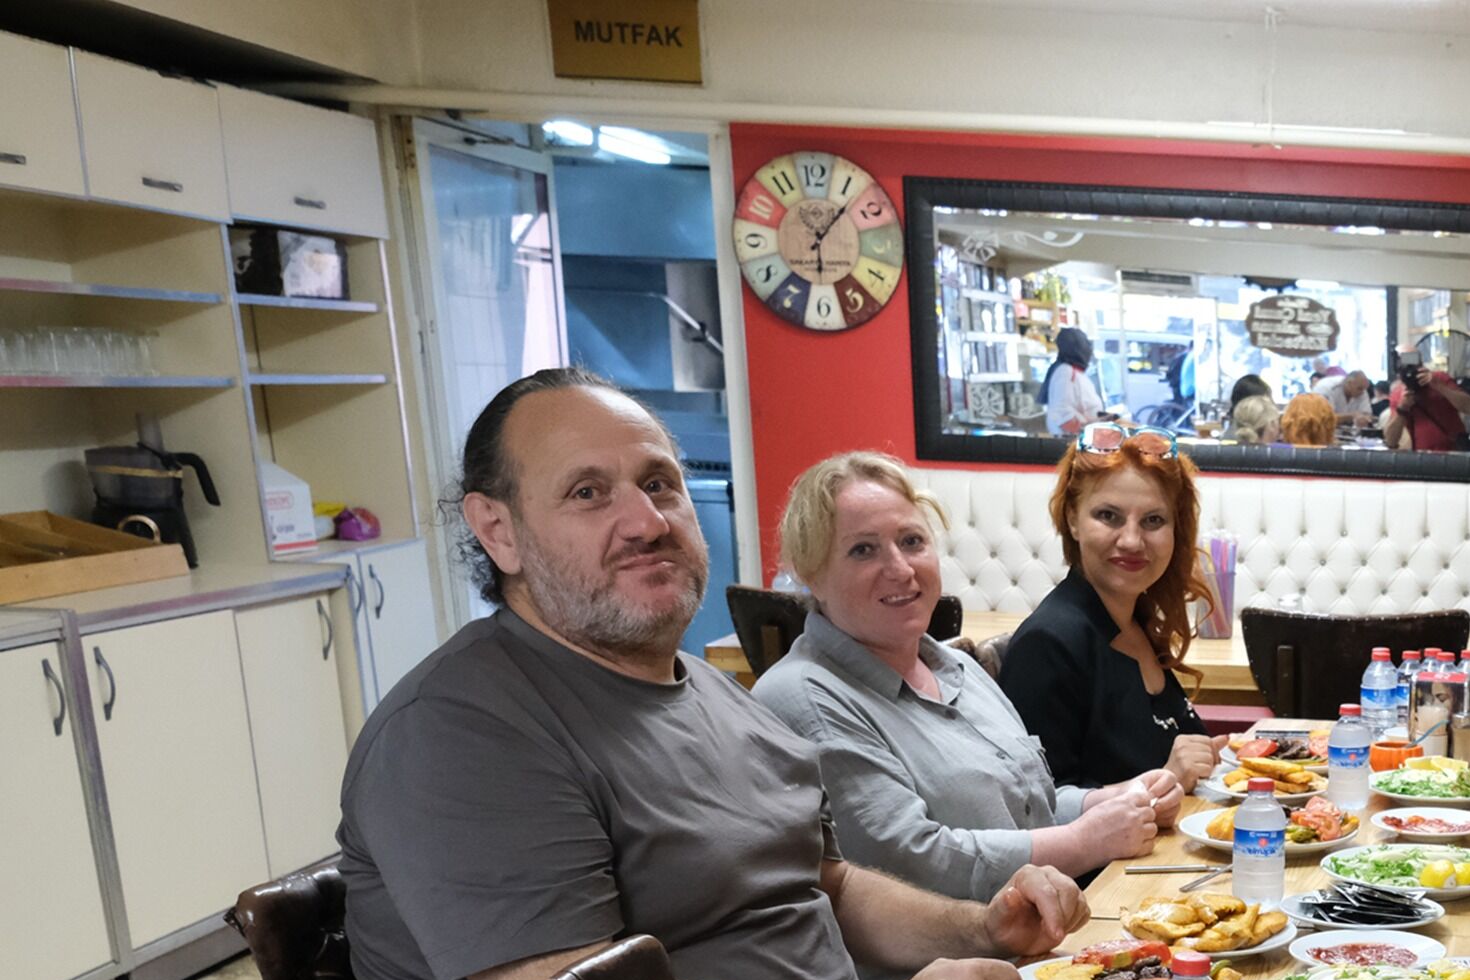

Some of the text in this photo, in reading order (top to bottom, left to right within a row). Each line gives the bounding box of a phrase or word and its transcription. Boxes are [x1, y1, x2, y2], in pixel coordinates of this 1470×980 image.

[575, 20, 682, 47] MUTFAK
[772, 171, 795, 196] 11
[803, 163, 826, 187] 12
[840, 176, 852, 196] 1
[748, 195, 775, 220] 10
[860, 201, 883, 220] 2
[745, 232, 768, 249] 9
[756, 264, 778, 284] 8
[782, 284, 802, 308] 7
[816, 294, 832, 319] 6
[844, 287, 865, 313] 5
